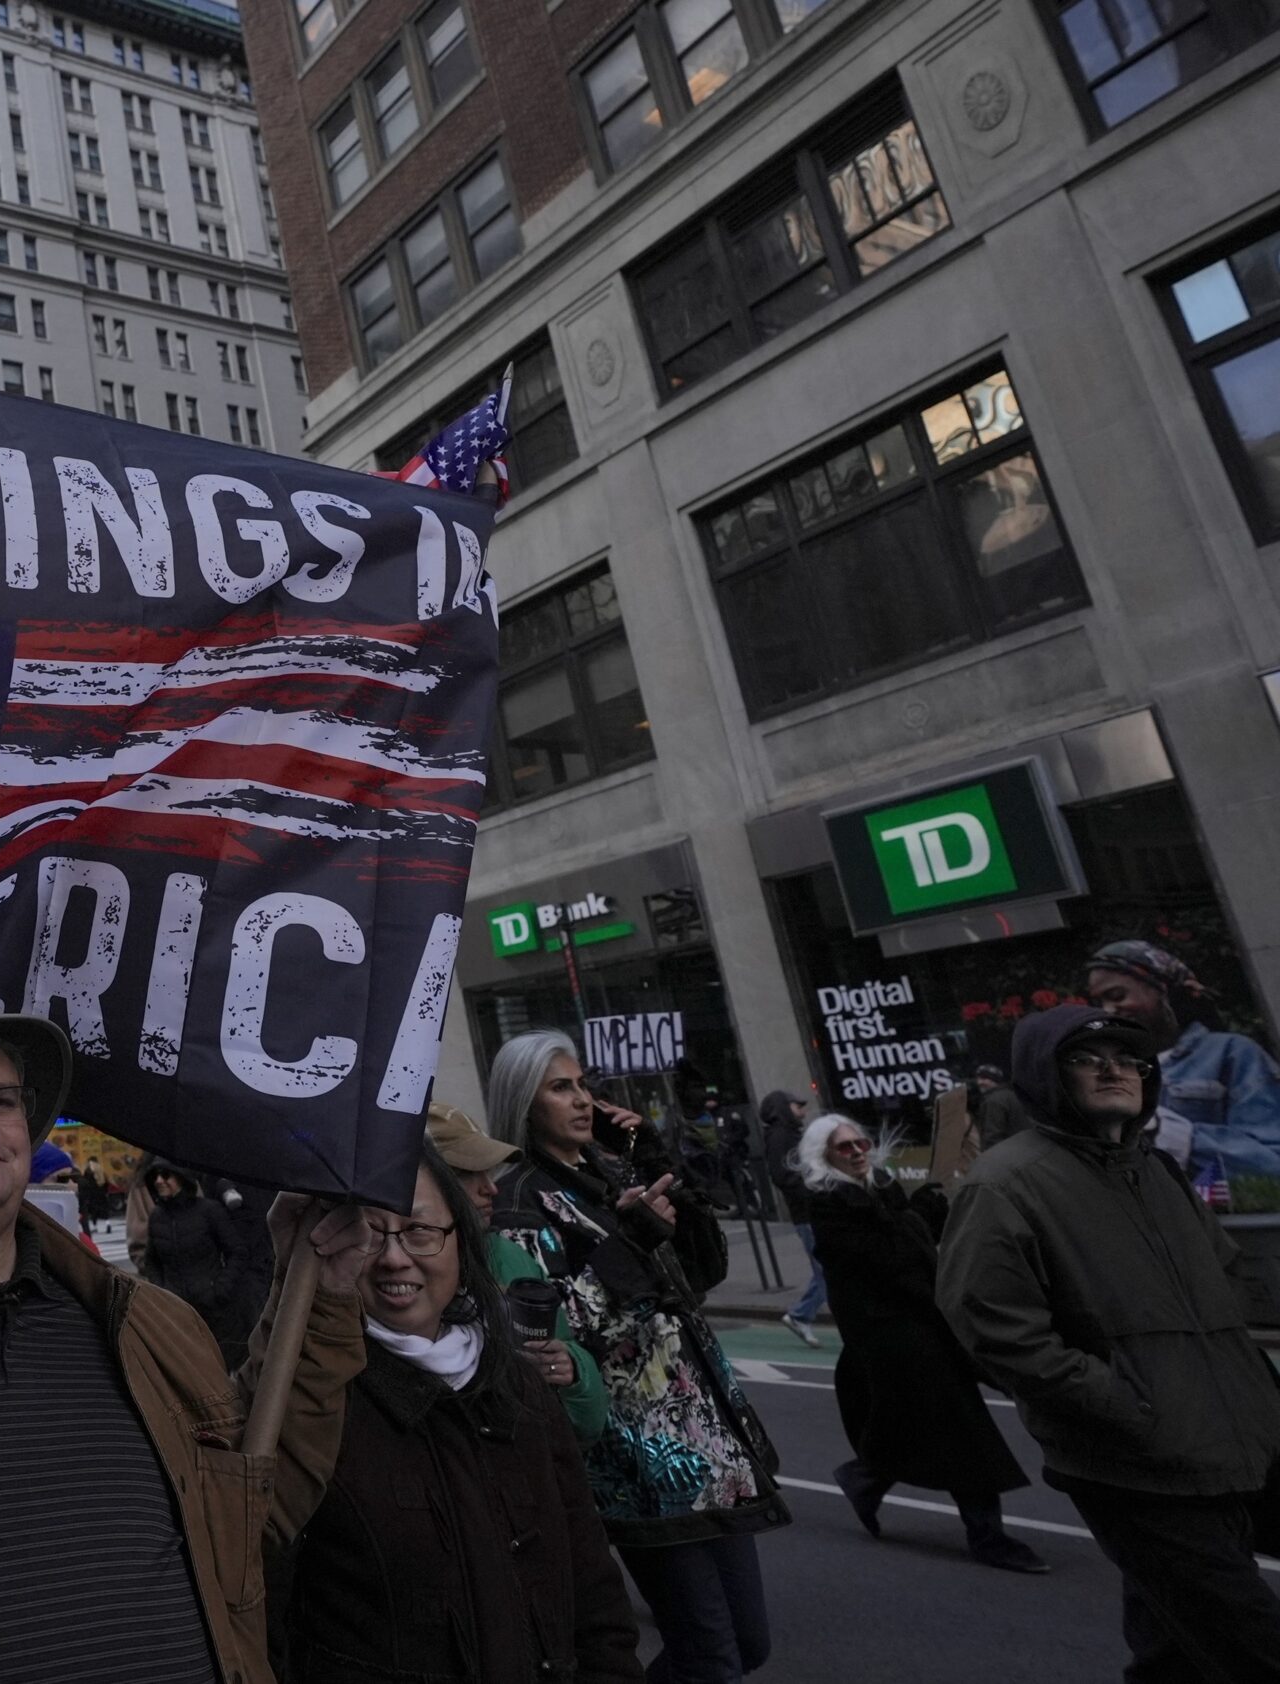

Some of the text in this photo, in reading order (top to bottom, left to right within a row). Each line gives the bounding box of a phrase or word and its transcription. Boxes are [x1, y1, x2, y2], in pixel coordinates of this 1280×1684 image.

[880, 811, 991, 887] TD
[492, 912, 530, 947] TD
[817, 975, 915, 1016] Digital
[825, 1010, 897, 1043] first.
[832, 1038, 946, 1071] Human
